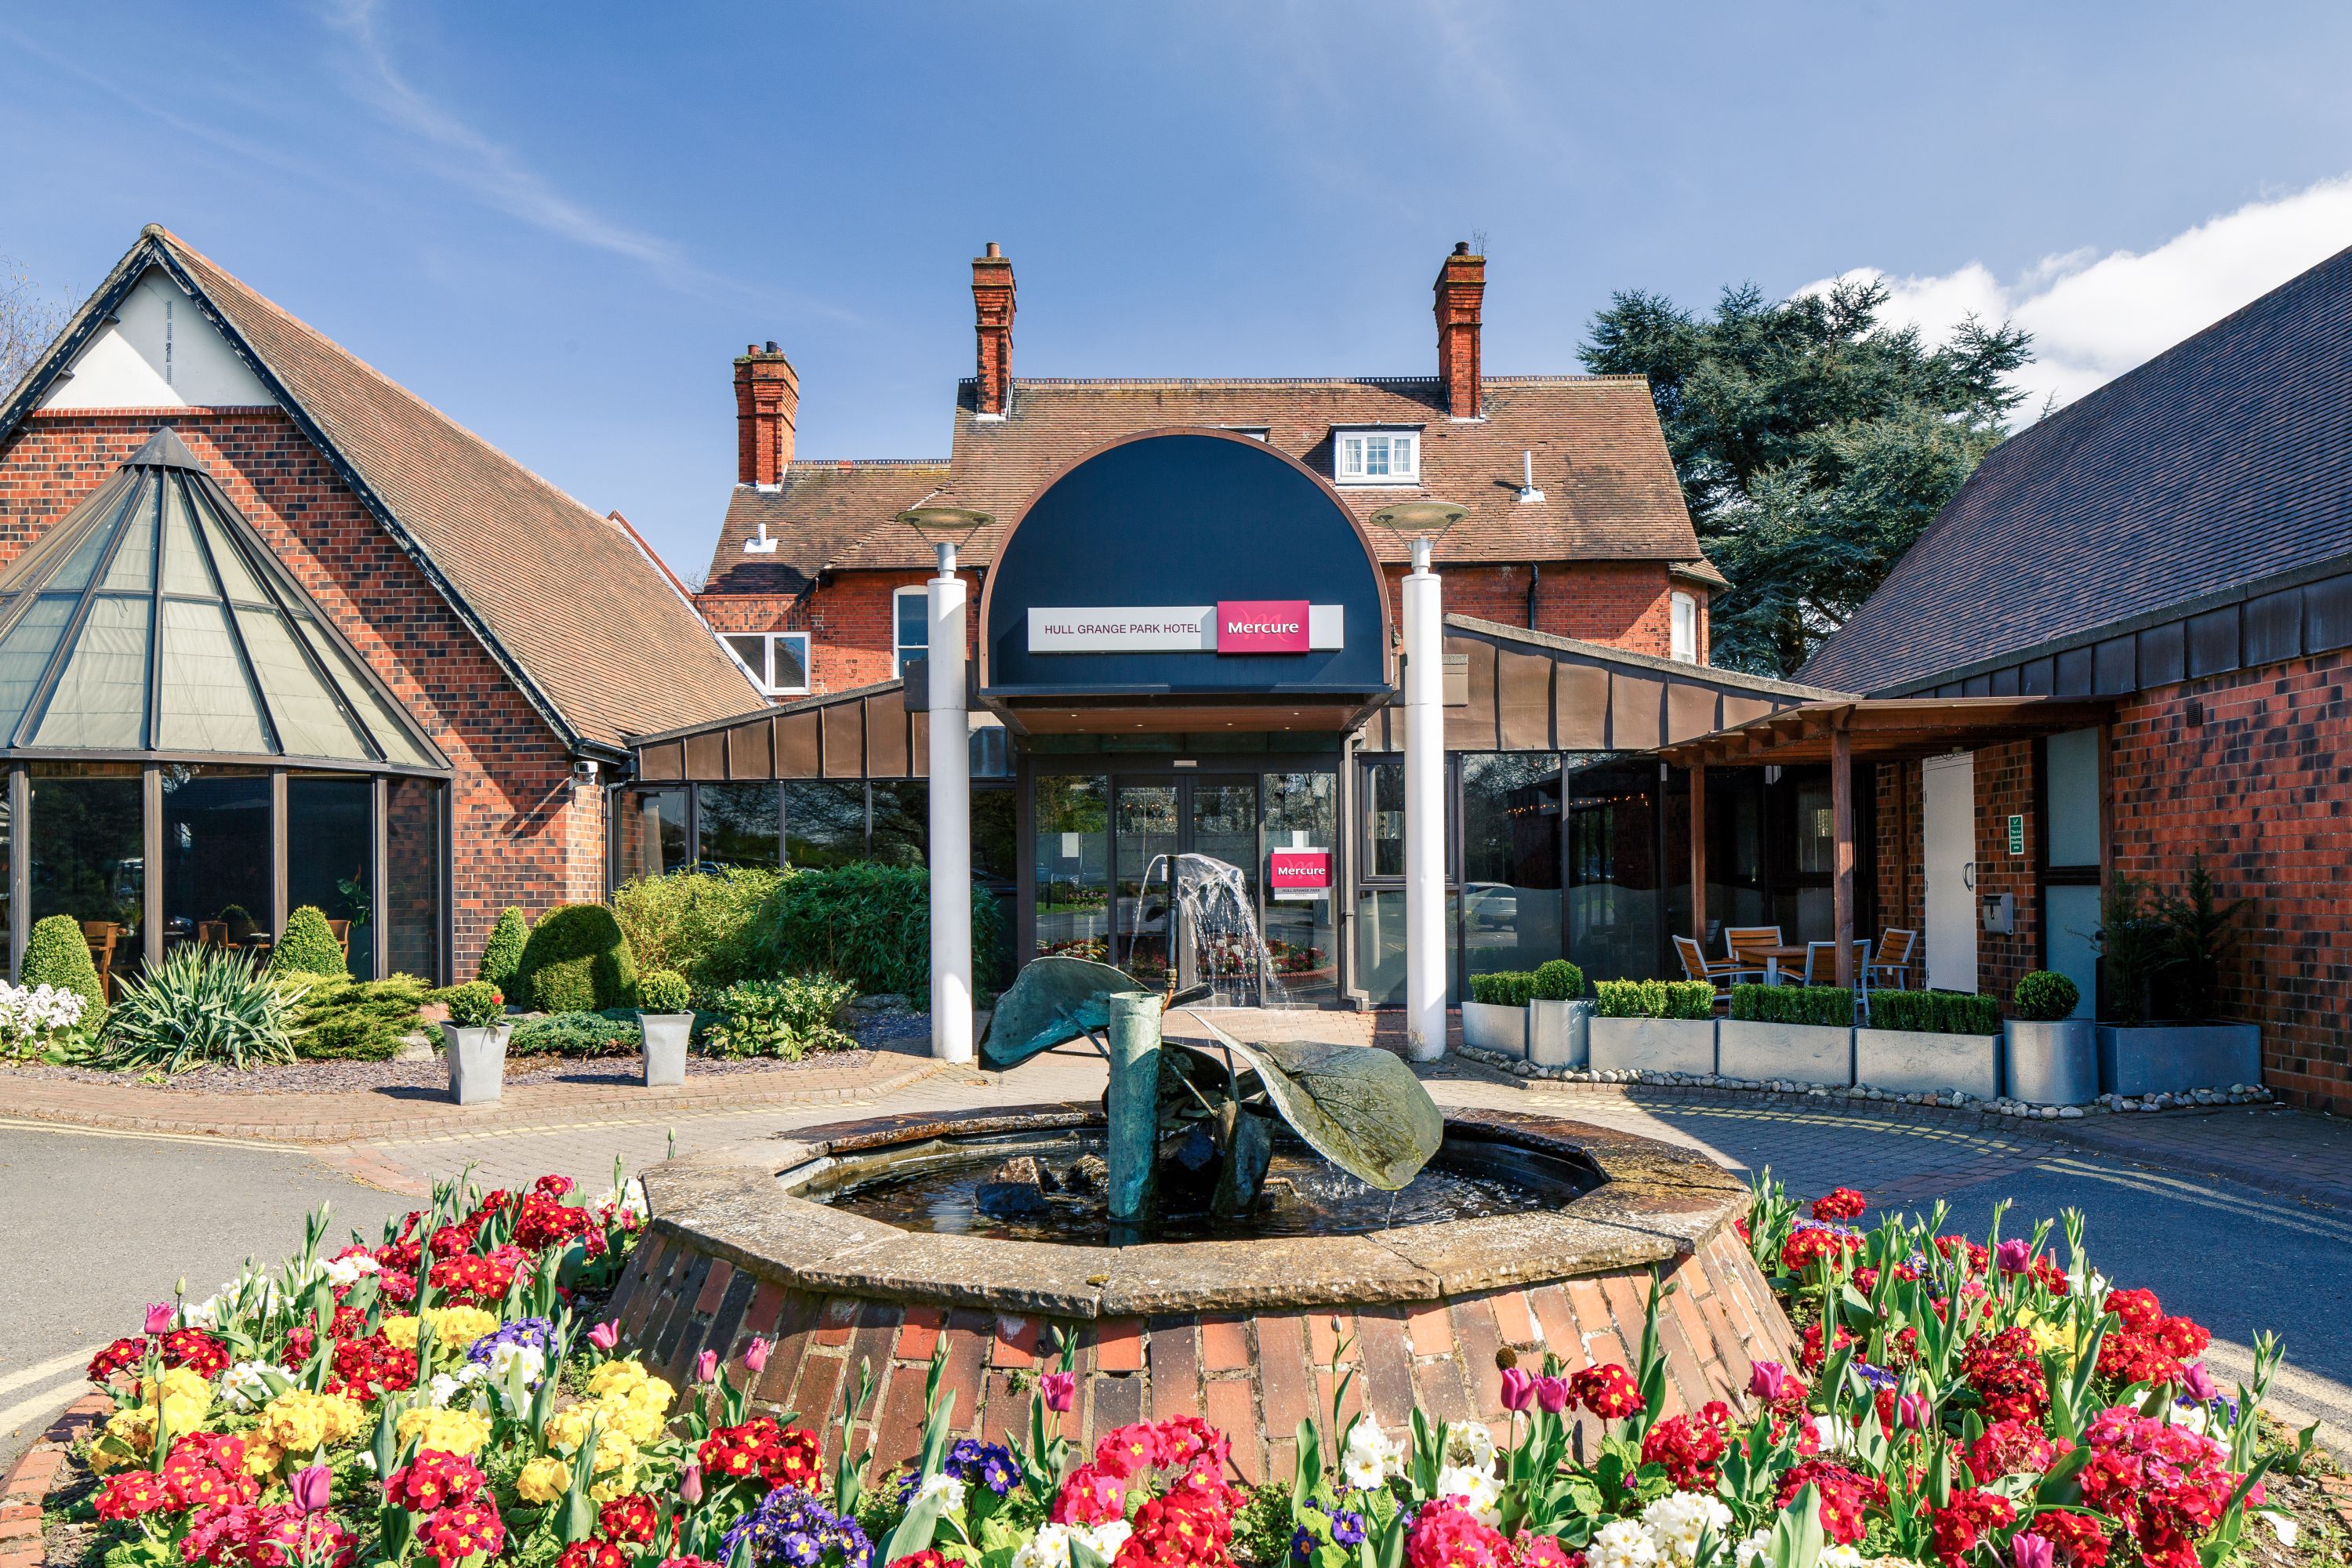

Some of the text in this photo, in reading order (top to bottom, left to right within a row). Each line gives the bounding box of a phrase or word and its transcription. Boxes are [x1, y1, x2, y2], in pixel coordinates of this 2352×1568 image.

[1044, 623, 1201, 634] HULL GRANGE PARK HOTEL
[1228, 622, 1299, 633] Mercure
[1278, 866, 1326, 875] Mercure
